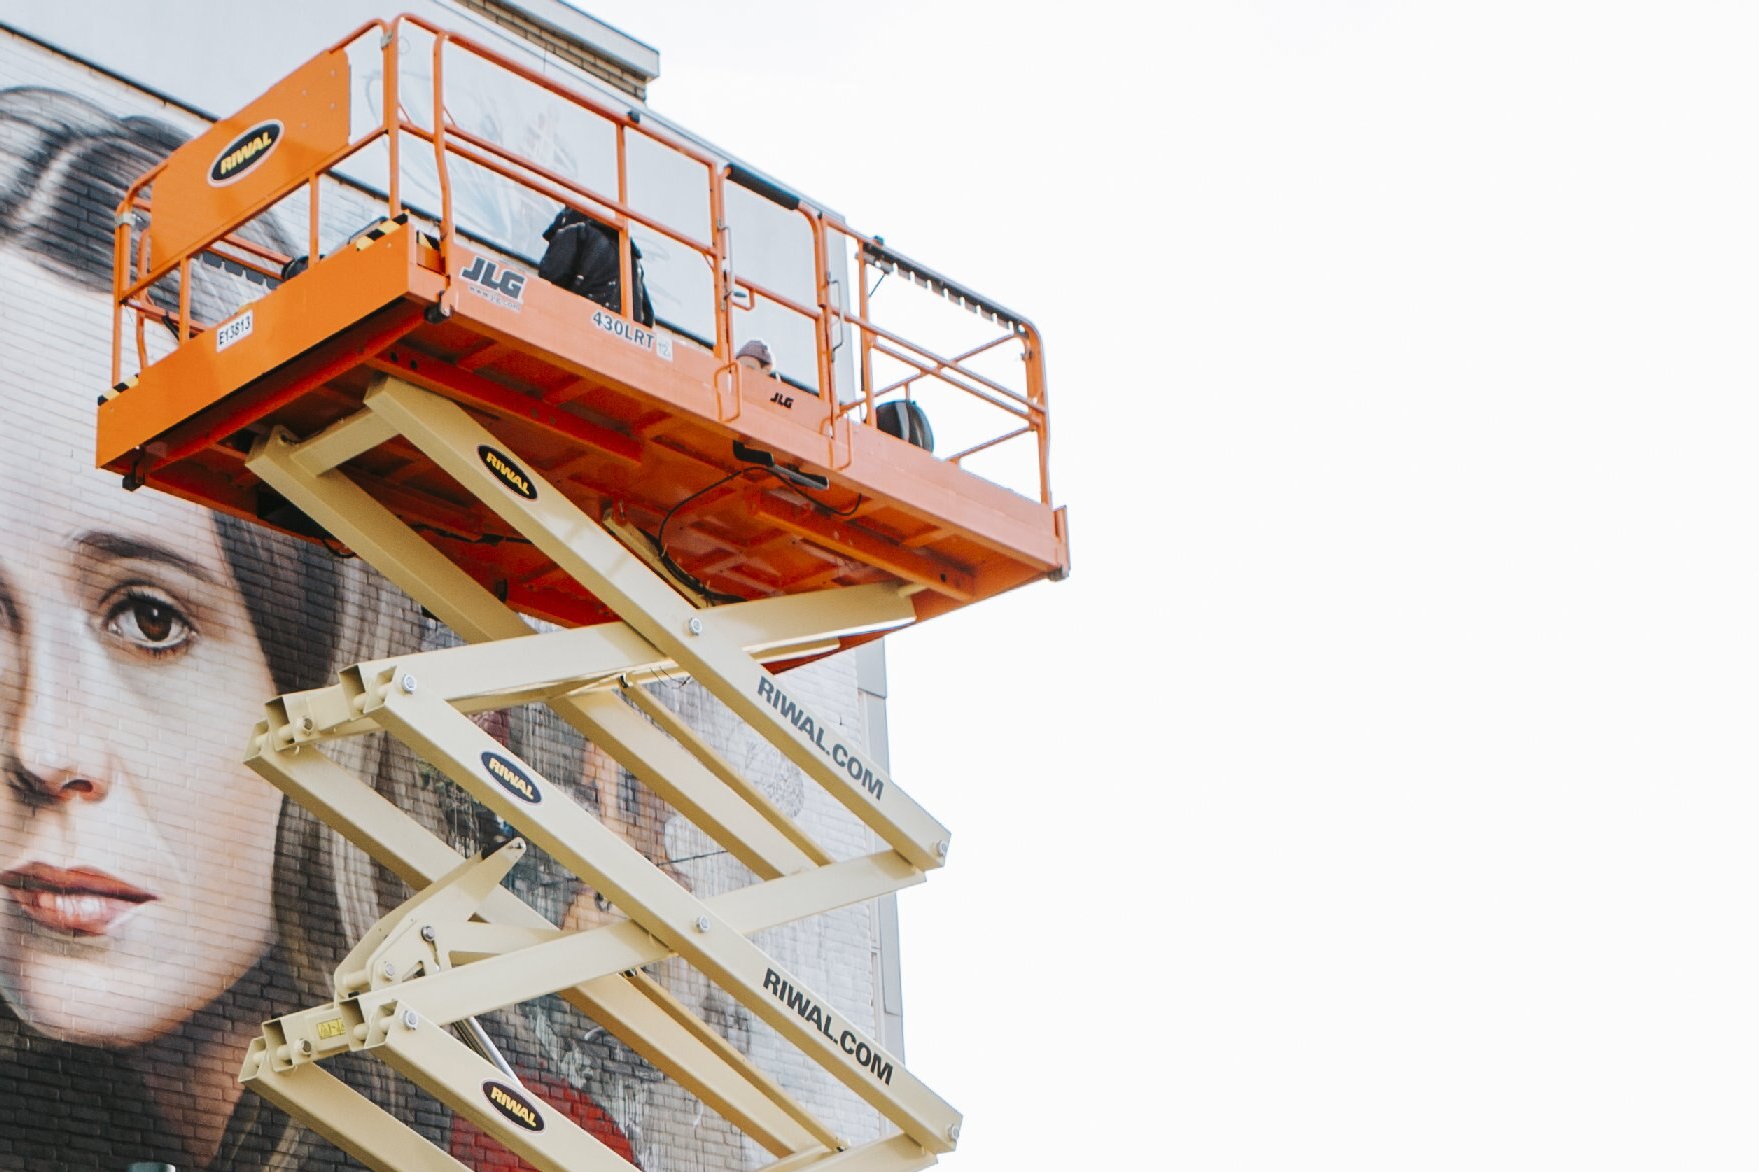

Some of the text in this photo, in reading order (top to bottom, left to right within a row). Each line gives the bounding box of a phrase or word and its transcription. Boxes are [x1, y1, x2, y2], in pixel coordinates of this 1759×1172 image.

[220, 131, 272, 175] RIWAL
[461, 256, 526, 300] JLG
[592, 311, 655, 349] 430LRT
[769, 391, 795, 409] JLG
[485, 451, 530, 496] RIWAL
[757, 675, 884, 801] RIWAL.COM
[488, 757, 534, 801] RIWAL
[762, 967, 893, 1086] RIWAL.COM
[490, 1086, 537, 1128] RIWAL
